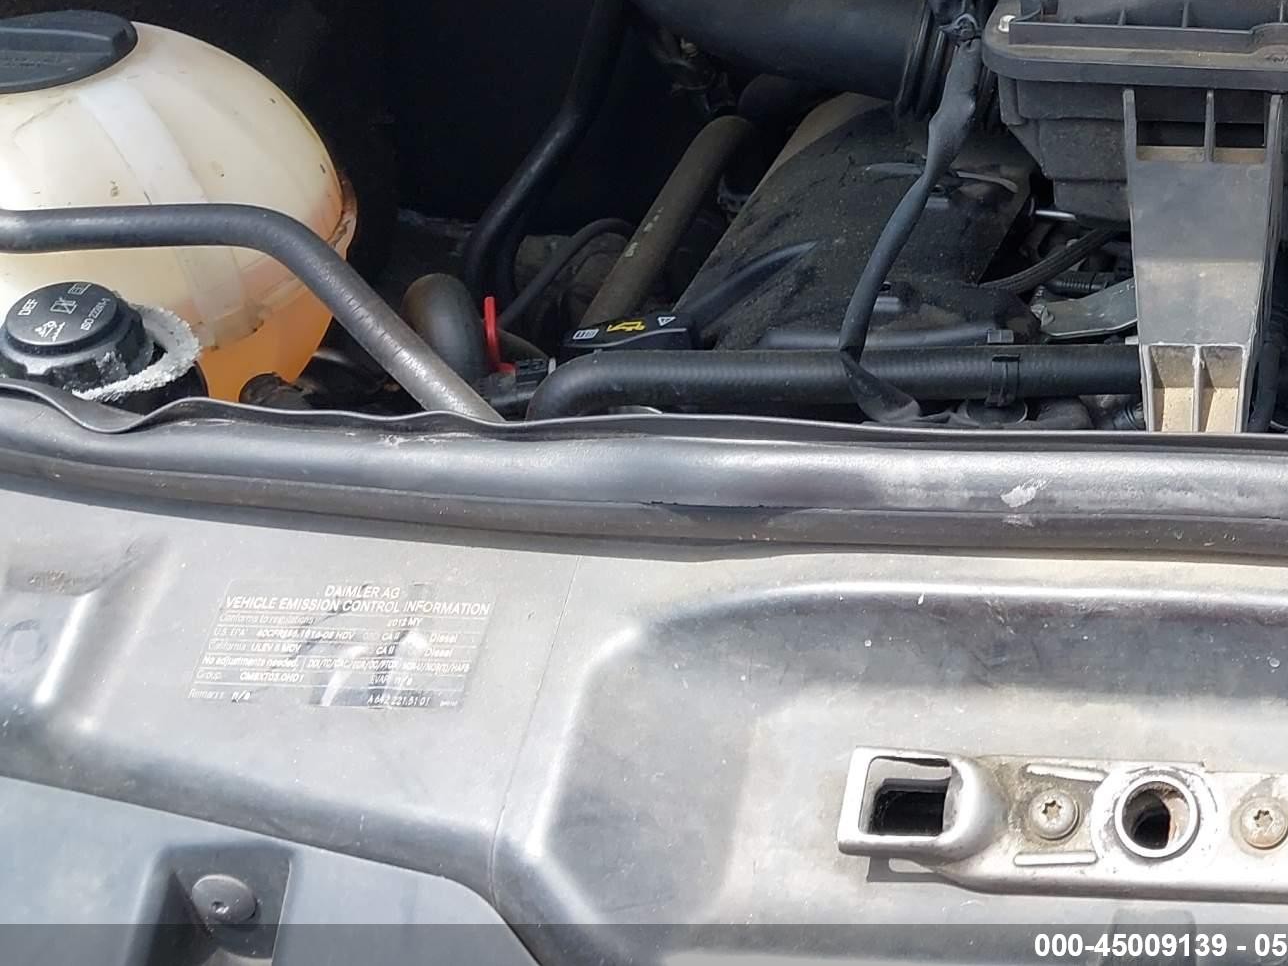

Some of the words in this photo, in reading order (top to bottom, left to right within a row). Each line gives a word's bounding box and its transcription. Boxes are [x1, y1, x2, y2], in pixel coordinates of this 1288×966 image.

[17, 298, 38, 316] DEF
[80, 317, 95, 331] ISO
[325, 585, 379, 598] DAIMLER
[380, 586, 401, 599] AG
[226, 596, 278, 609] VEHICLE
[278, 598, 339, 611] EMISSION
[342, 600, 400, 613] CONTROL
[402, 600, 490, 616] INFORMATION
[408, 616, 423, 627] MY
[429, 633, 458, 643] Diesel
[376, 645, 388, 654] CA
[424, 647, 453, 658] Diesel
[202, 656, 214, 664] No
